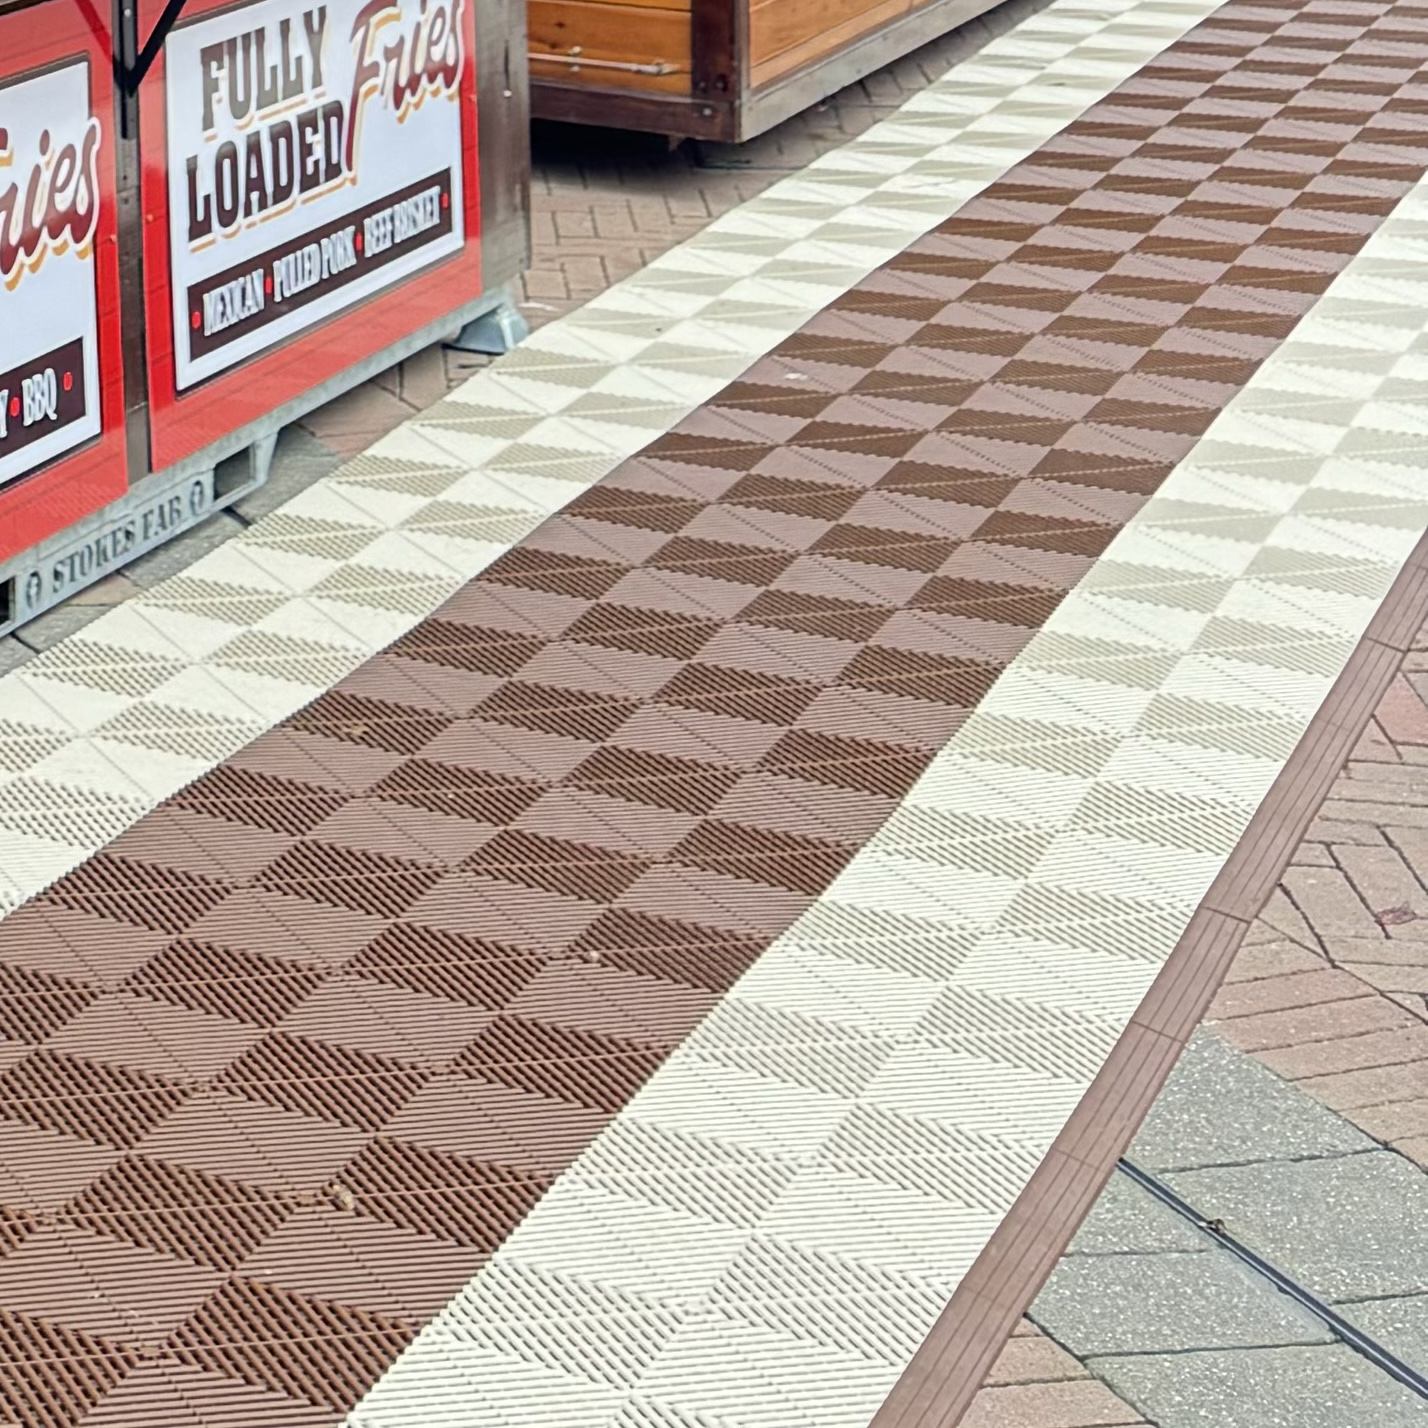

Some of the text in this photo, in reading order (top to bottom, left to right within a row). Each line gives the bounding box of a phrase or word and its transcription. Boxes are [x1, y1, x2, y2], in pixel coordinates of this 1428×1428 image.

[200, 5, 330, 142] FULLY
[186, 99, 348, 254] LOADED
[202, 268, 264, 337] MEXICAN
[272, 243, 320, 303] PULLED
[20, 366, 58, 423] BBQ
